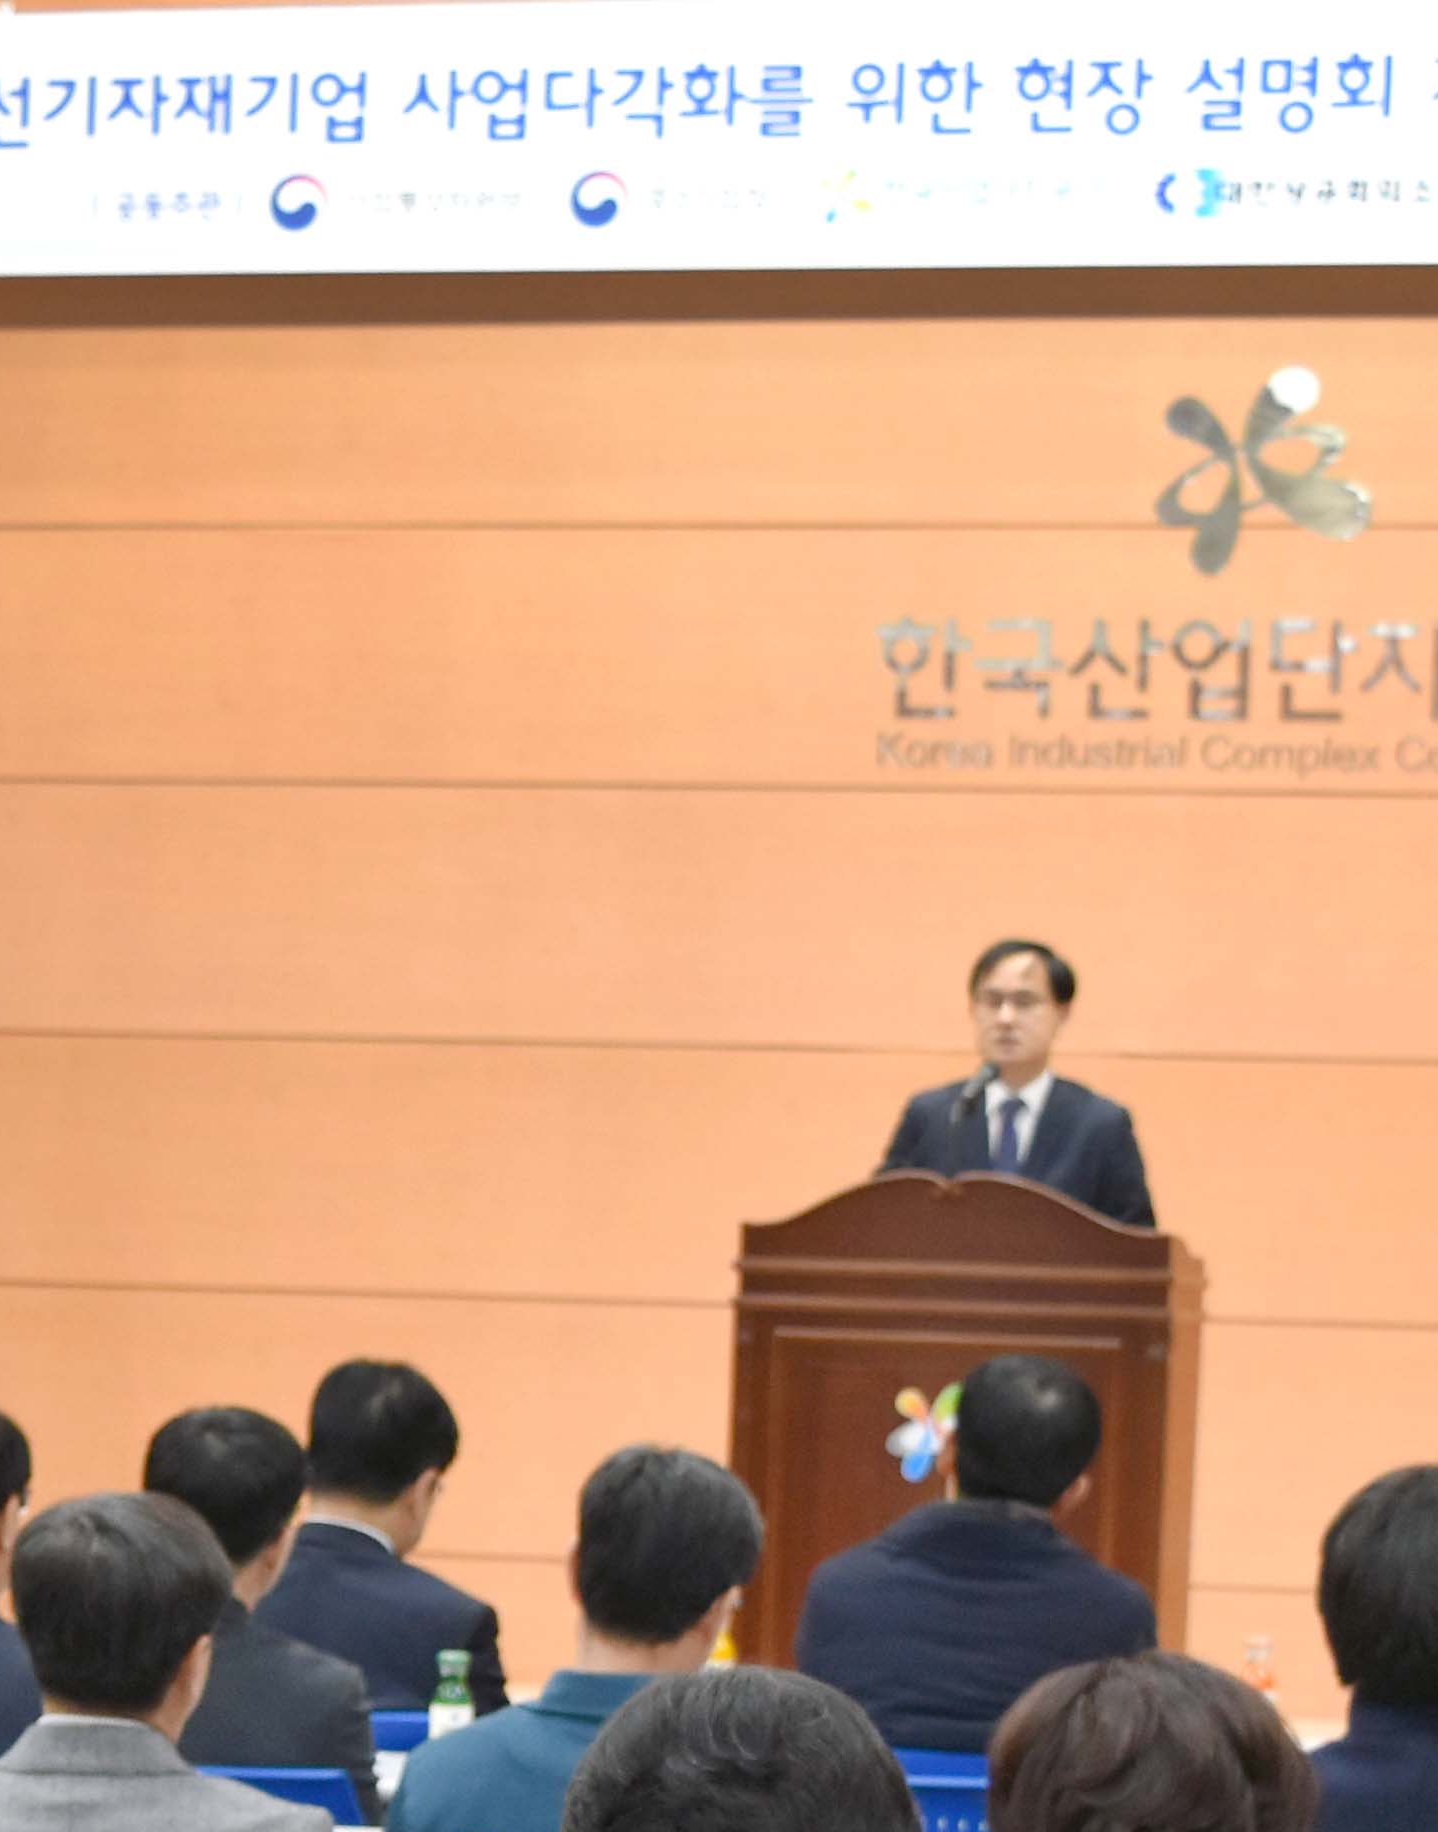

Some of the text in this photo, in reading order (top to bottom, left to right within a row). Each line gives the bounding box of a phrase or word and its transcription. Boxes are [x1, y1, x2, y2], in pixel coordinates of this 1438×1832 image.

[403, 63, 815, 142] 사업다각화를
[845, 58, 984, 136] 위한
[1014, 57, 1155, 136] 현장
[1185, 52, 1394, 134] 설명회
[877, 734, 993, 768] Korea
[1008, 734, 1188, 769] Industrial
[1201, 735, 1378, 777] Complex
